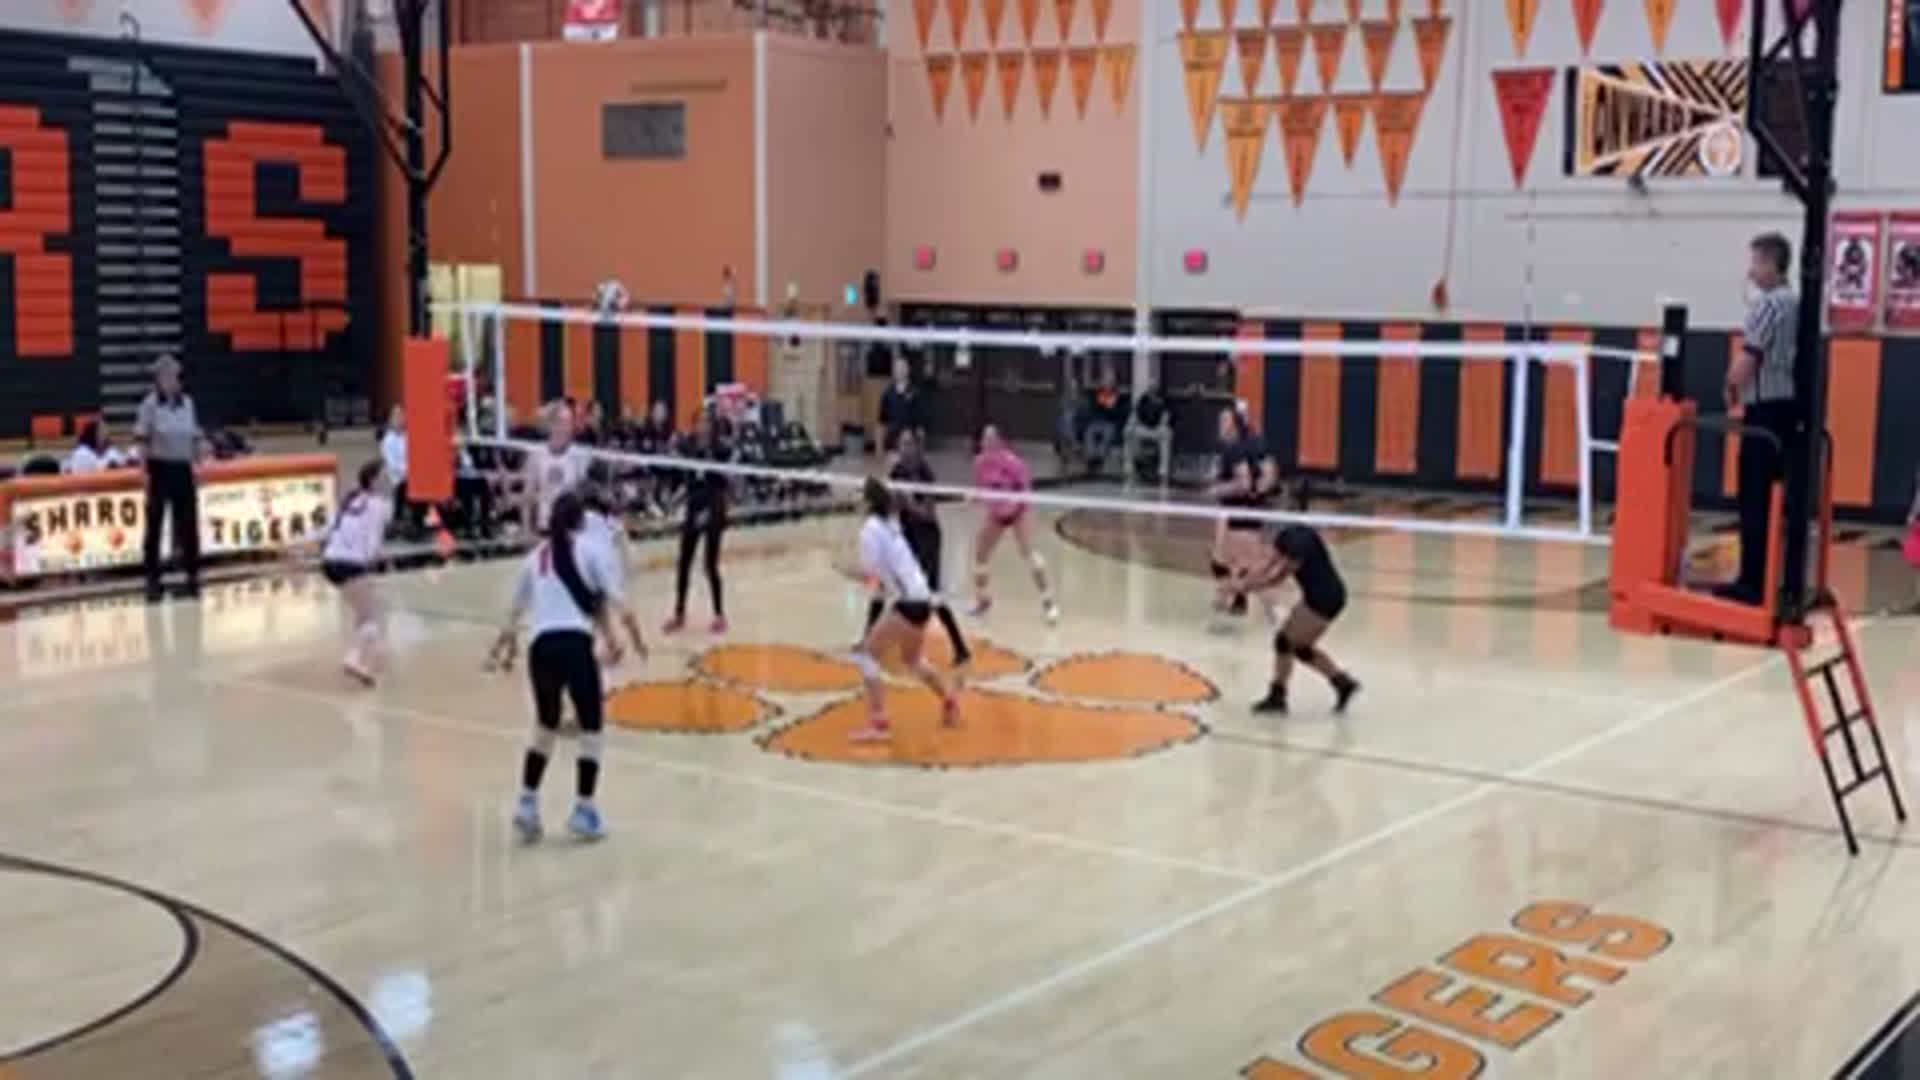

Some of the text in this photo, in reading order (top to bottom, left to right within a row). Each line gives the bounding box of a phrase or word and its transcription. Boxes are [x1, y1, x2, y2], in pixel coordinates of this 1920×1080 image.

[24, 497, 138, 546] SHARO
[209, 504, 327, 545] TIGERS
[1239, 898, 1674, 1080] GERS
